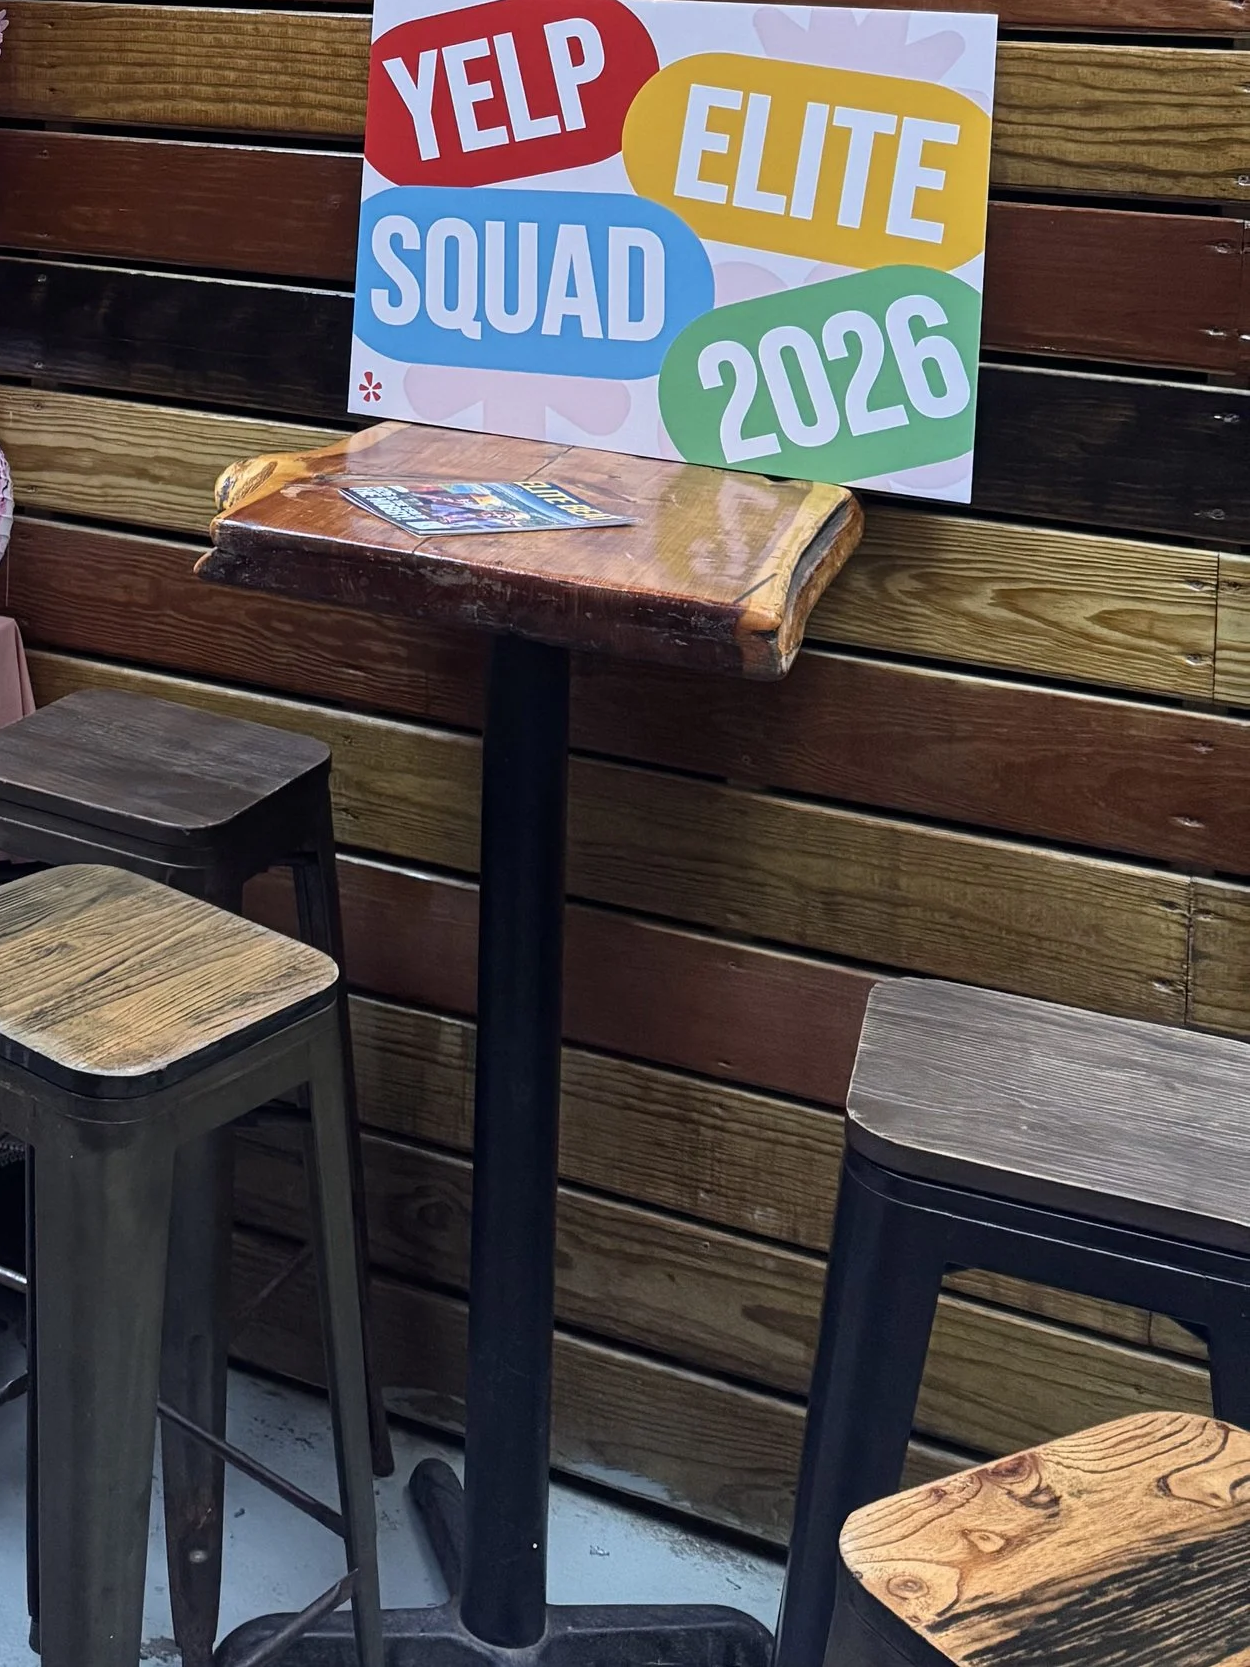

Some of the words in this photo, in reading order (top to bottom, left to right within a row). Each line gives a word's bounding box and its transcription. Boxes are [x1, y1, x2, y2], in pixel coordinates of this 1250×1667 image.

[383, 17, 605, 162] YELP
[673, 83, 960, 244] ELITE
[370, 214, 666, 343] SQUAD
[697, 294, 972, 464] 2026
[513, 481, 580, 504] ELITE
